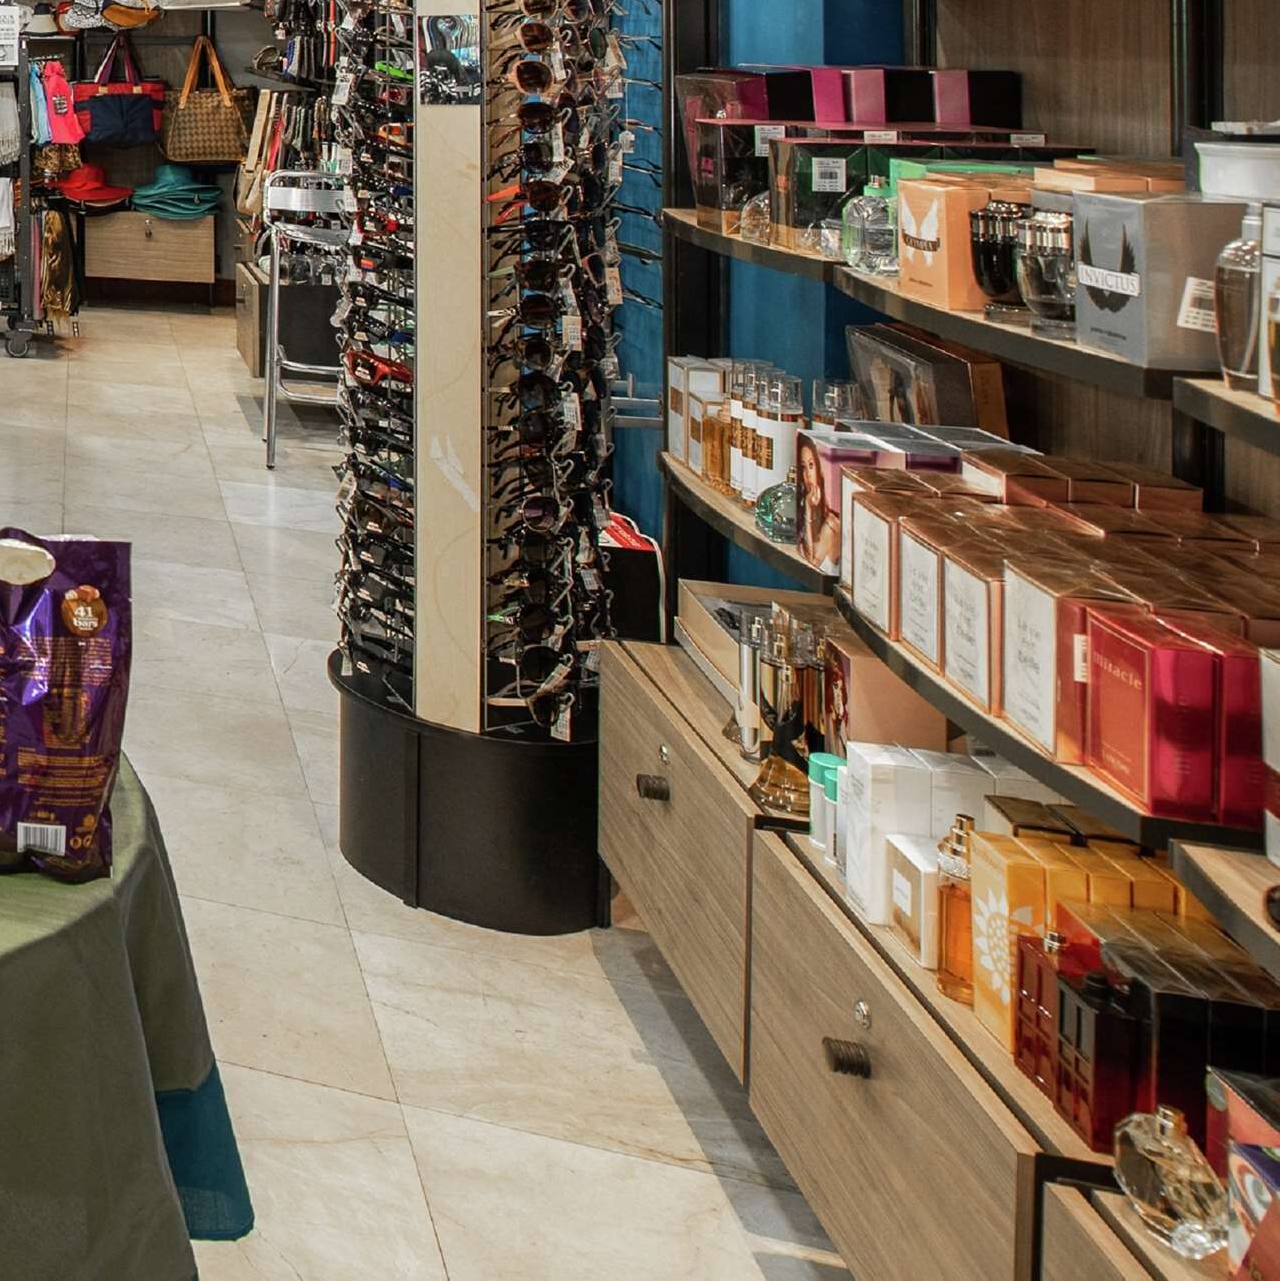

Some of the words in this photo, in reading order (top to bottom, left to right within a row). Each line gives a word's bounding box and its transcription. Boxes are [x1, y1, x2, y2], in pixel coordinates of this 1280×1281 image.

[1080, 265, 1137, 293] INVICTUS
[74, 607, 93, 617] 41
[75, 619, 97, 629] bars
[1092, 651, 1142, 690] miracle
